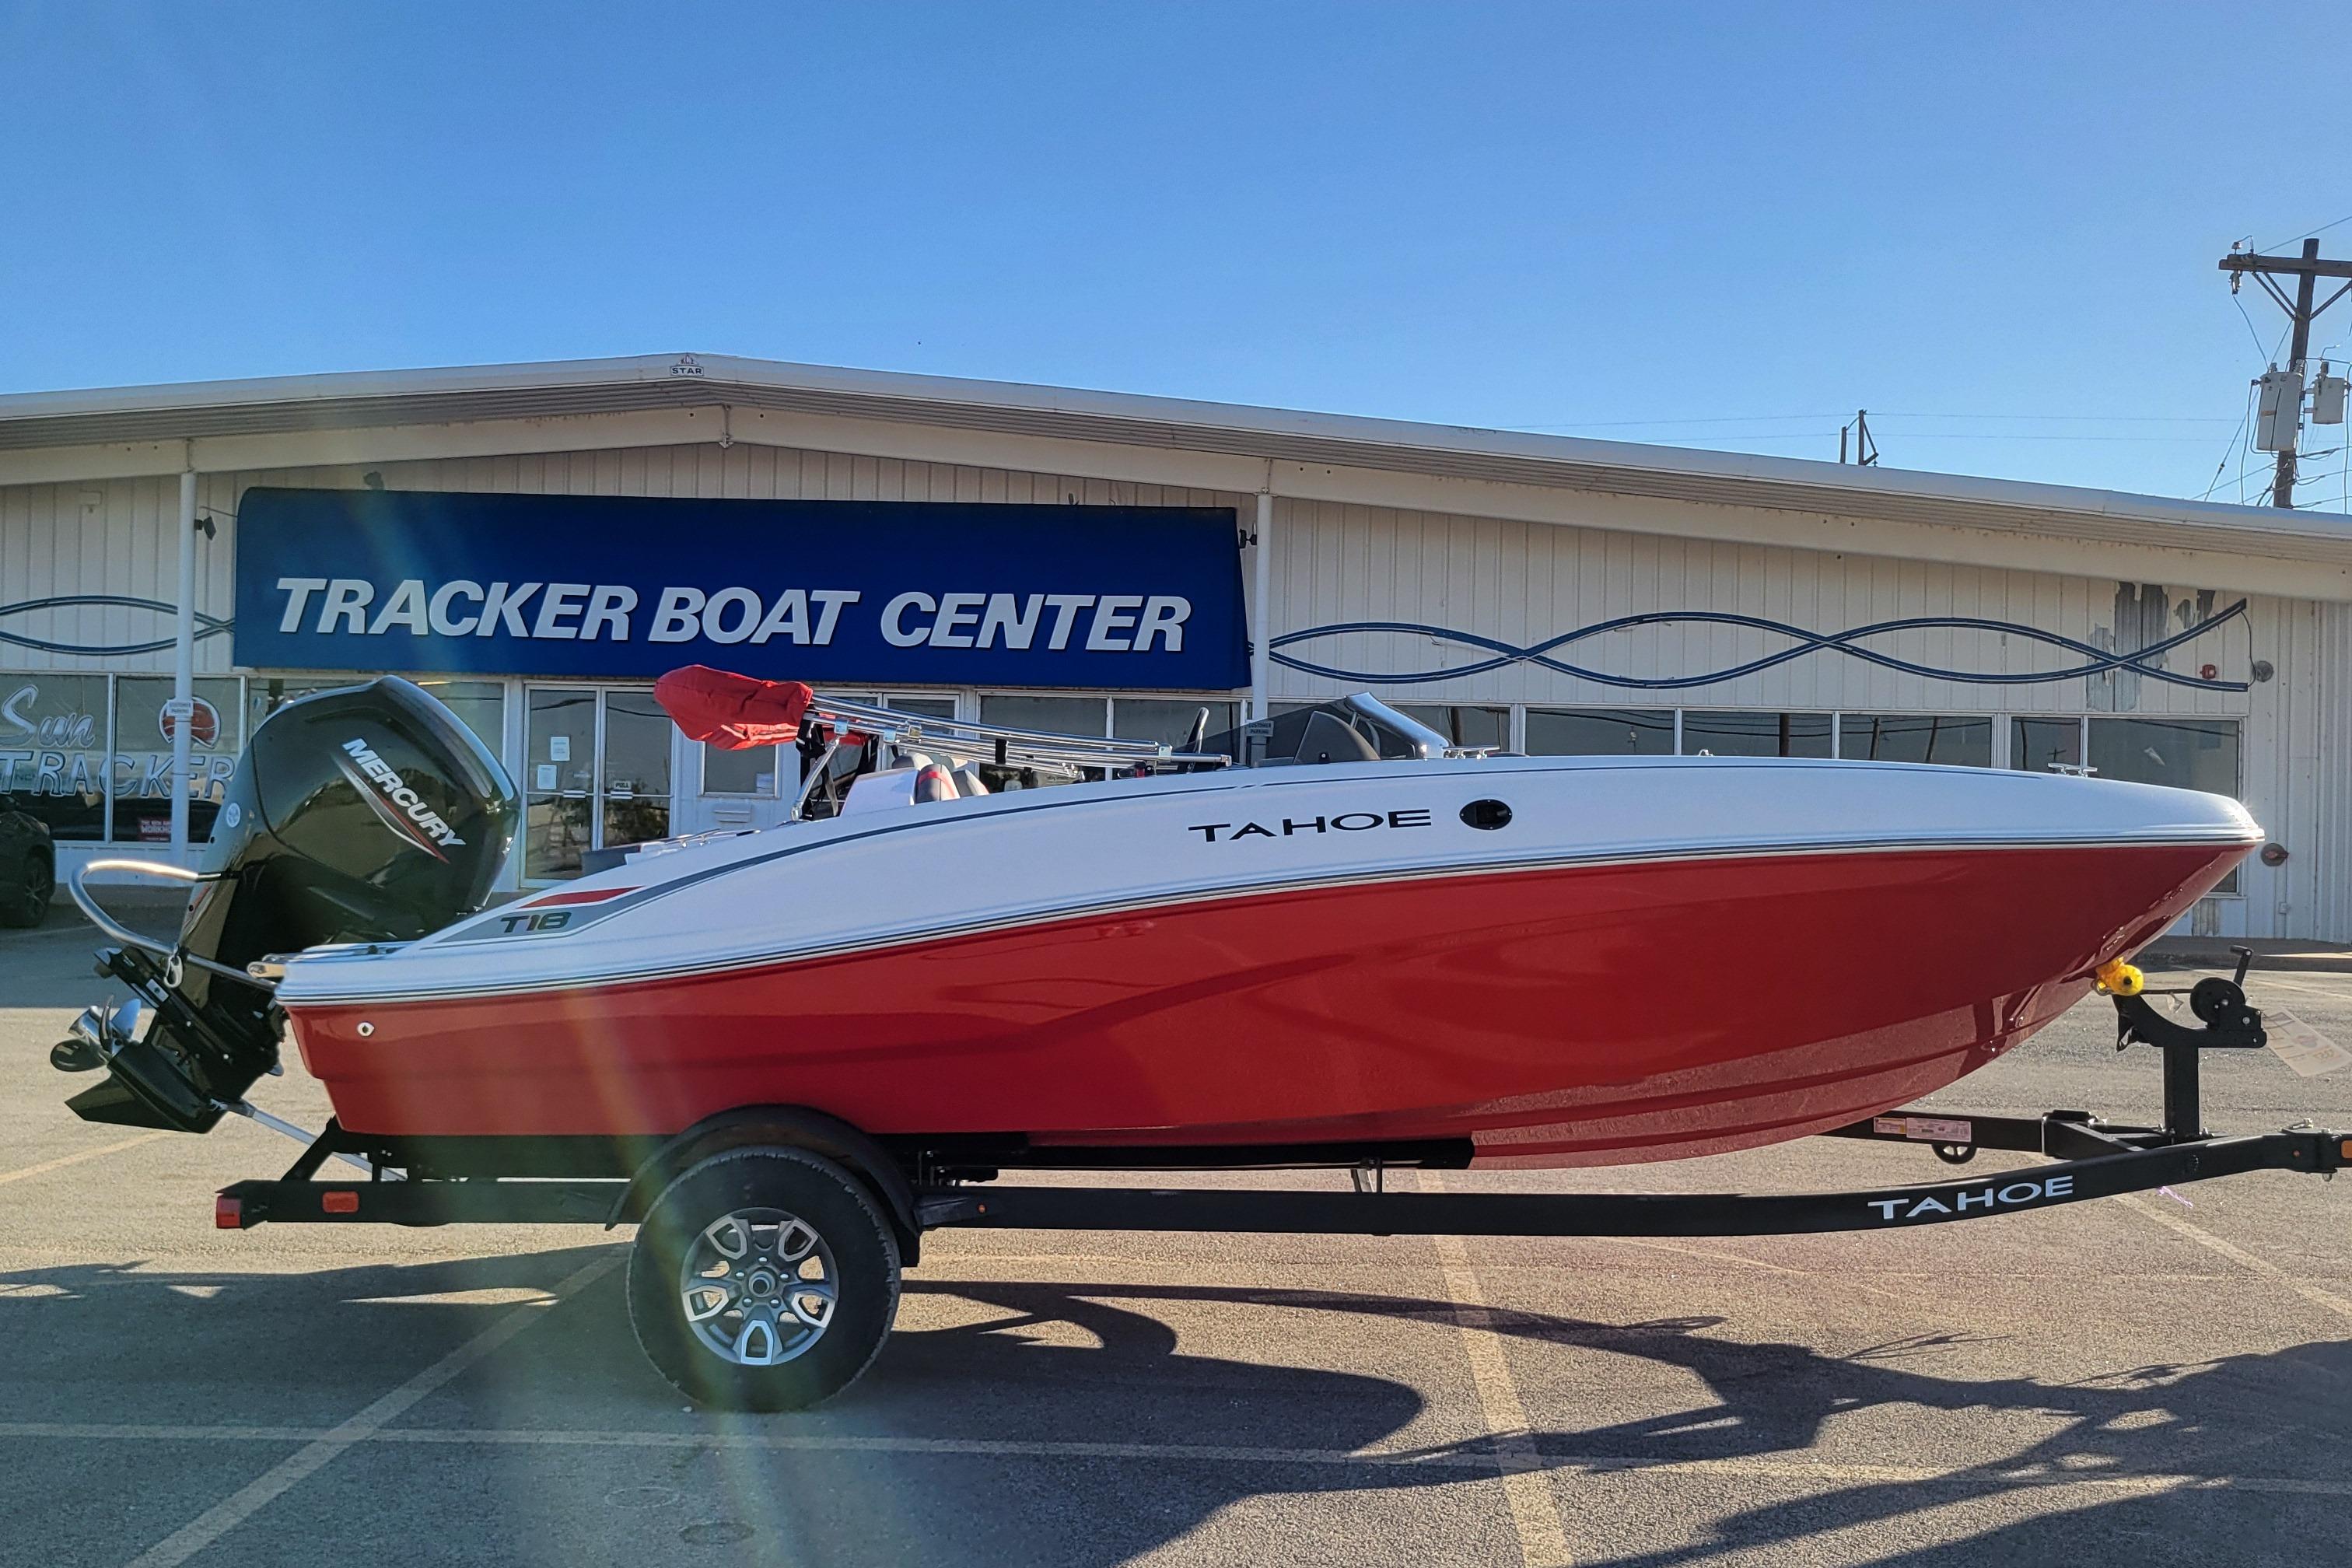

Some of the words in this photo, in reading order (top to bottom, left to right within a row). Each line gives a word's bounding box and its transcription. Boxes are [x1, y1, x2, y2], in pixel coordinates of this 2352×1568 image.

[275, 576, 639, 641] TRACKER
[648, 586, 861, 646] BOAT
[880, 590, 1192, 652] CENTER
[0, 684, 95, 747] Sun
[342, 738, 467, 846] MERCURY
[1188, 809, 1432, 842] TAHOE
[500, 912, 572, 933] T18
[1867, 1175, 2074, 1220] TAHOE
